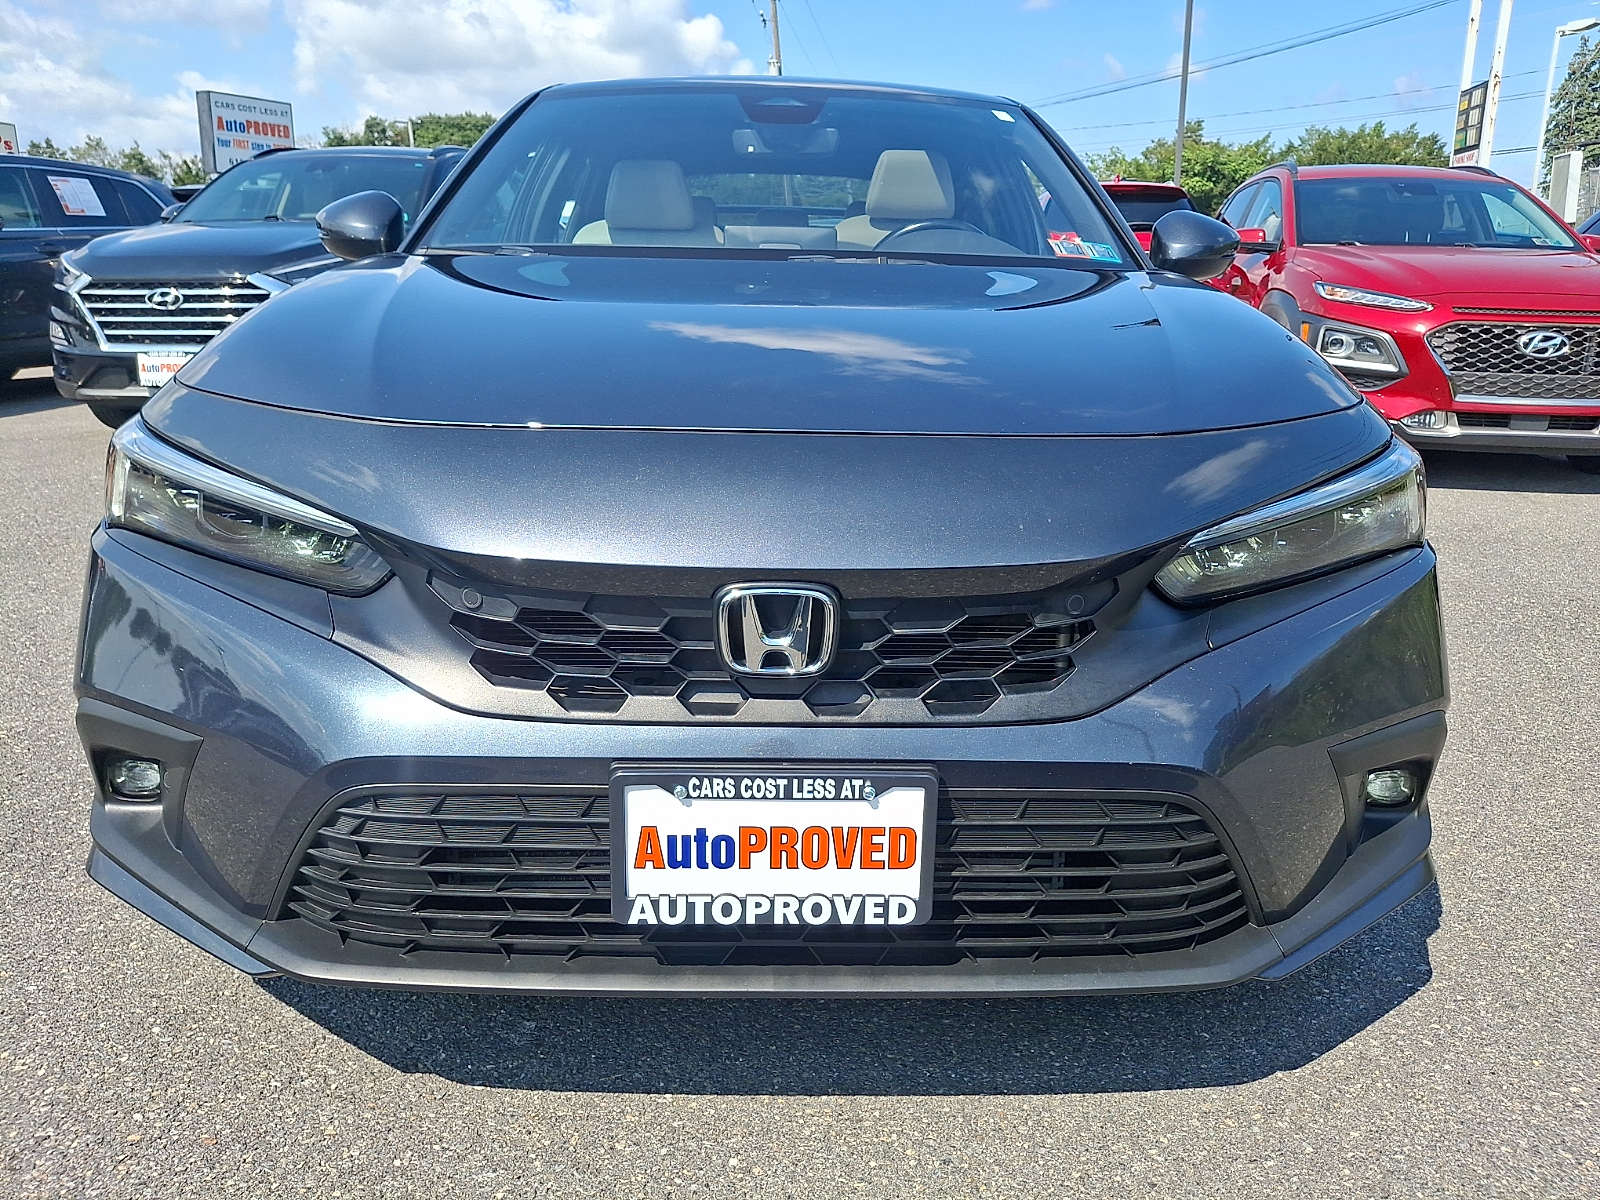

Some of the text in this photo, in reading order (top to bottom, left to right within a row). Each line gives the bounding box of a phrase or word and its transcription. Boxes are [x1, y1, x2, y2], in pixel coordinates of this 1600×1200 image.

[215, 101, 235, 110] CARS
[238, 104, 256, 113] COST
[260, 107, 278, 116] LESS
[217, 115, 290, 138] AutoPROVED
[216, 137, 231, 148] Your
[232, 138, 249, 150] FIRST
[688, 776, 864, 800] CARS COST LESS AT
[633, 825, 917, 870] AutoPROVED
[628, 893, 917, 925] AUTOPROVED
